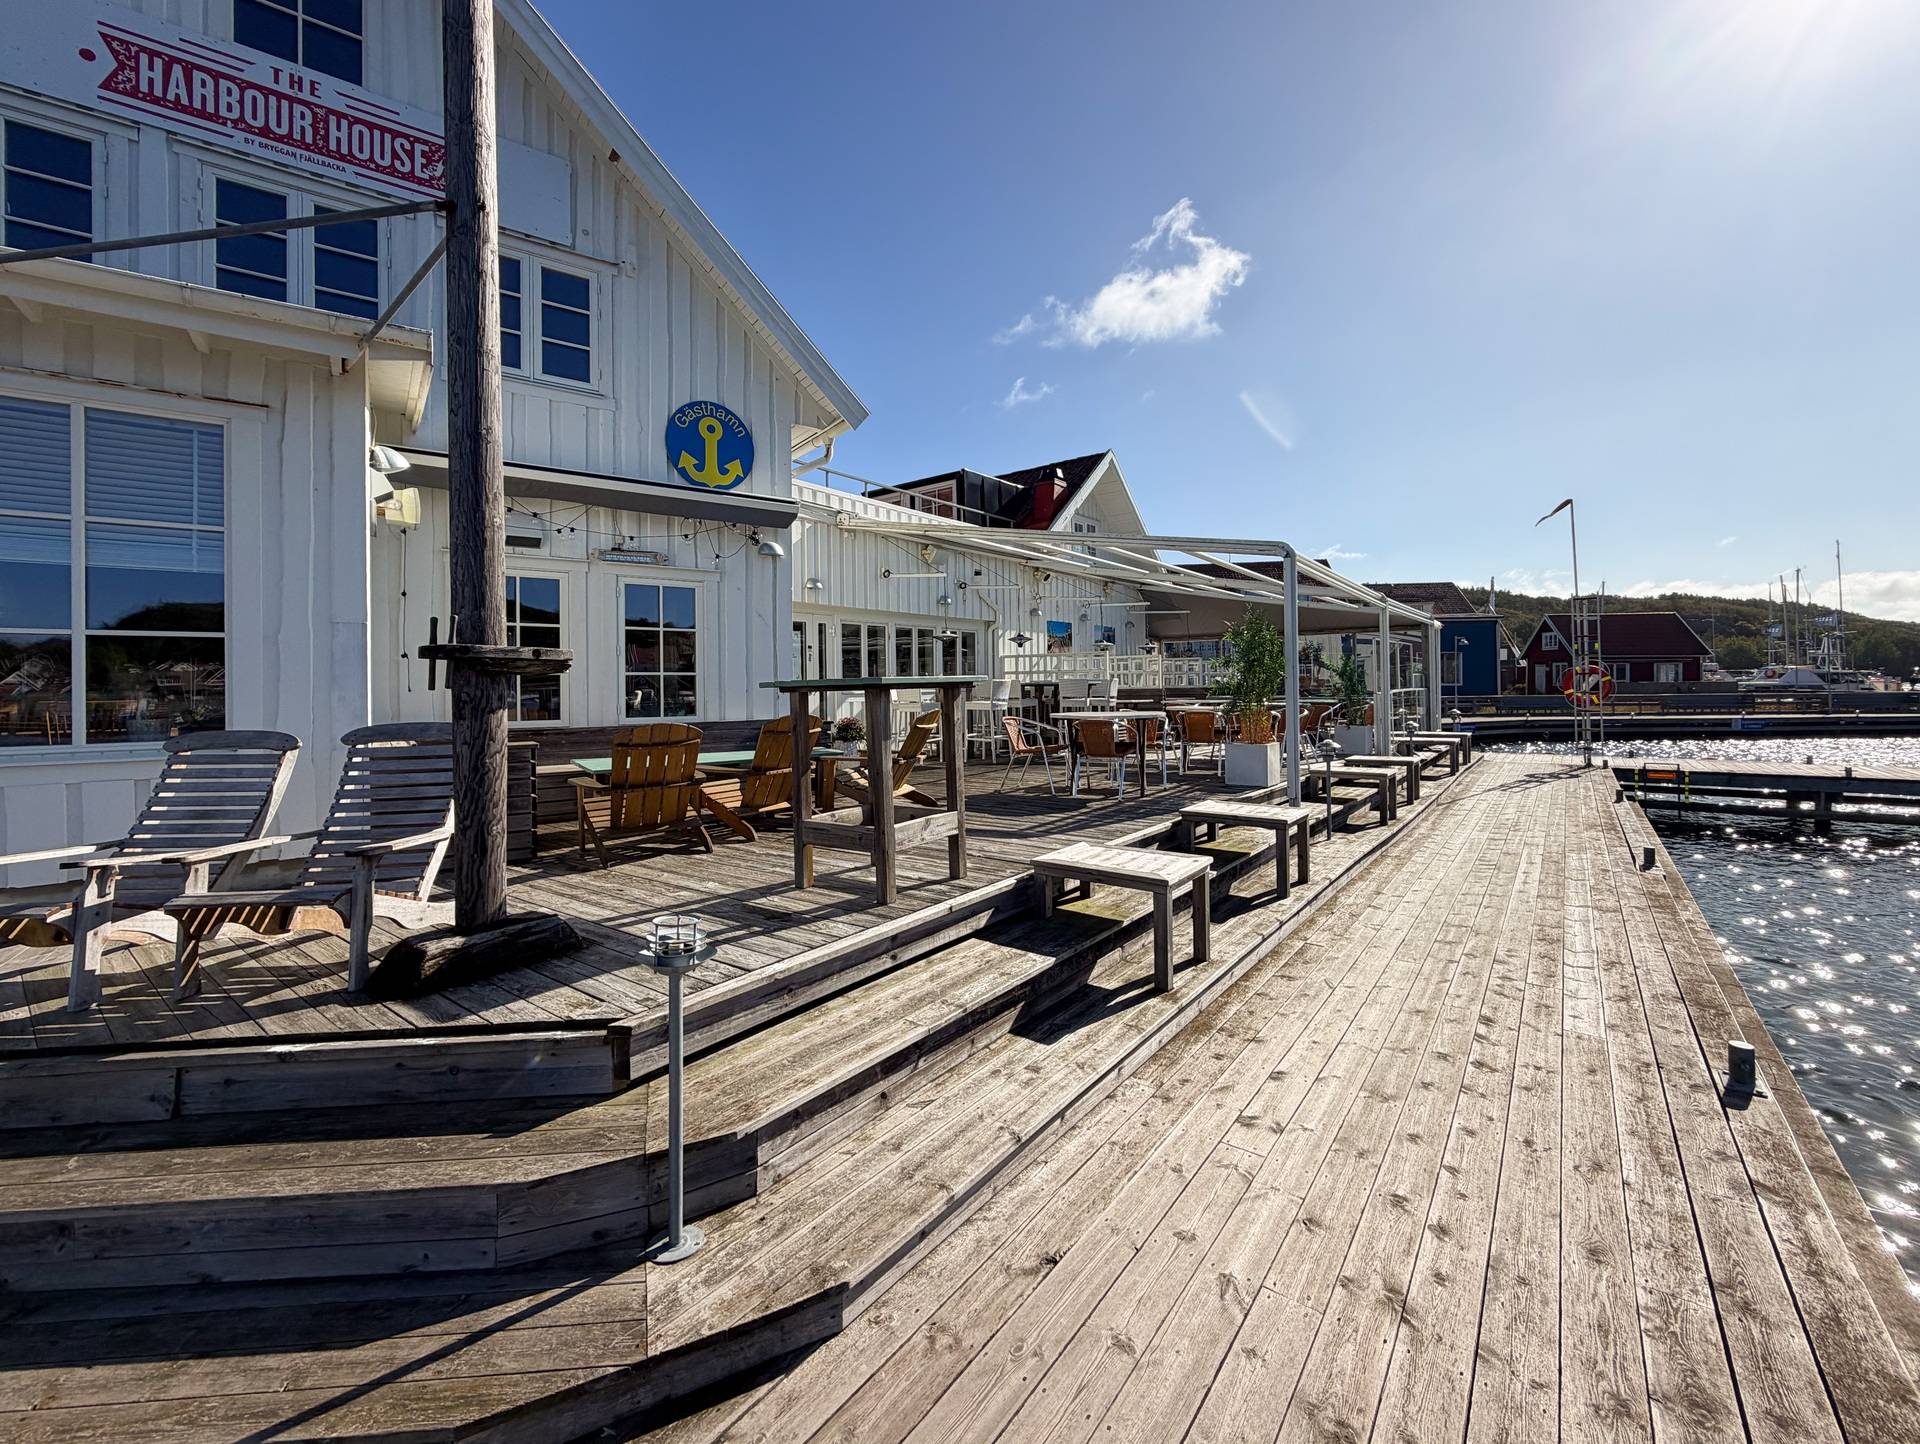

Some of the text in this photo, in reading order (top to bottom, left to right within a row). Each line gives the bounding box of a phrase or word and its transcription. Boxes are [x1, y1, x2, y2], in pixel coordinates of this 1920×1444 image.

[269, 65, 322, 100] THE
[138, 52, 430, 180] HARBOUR HOUSE
[243, 137, 347, 173] BY BRYGGAN FJÄLLBACKA
[674, 402, 746, 438] Gästhamn
